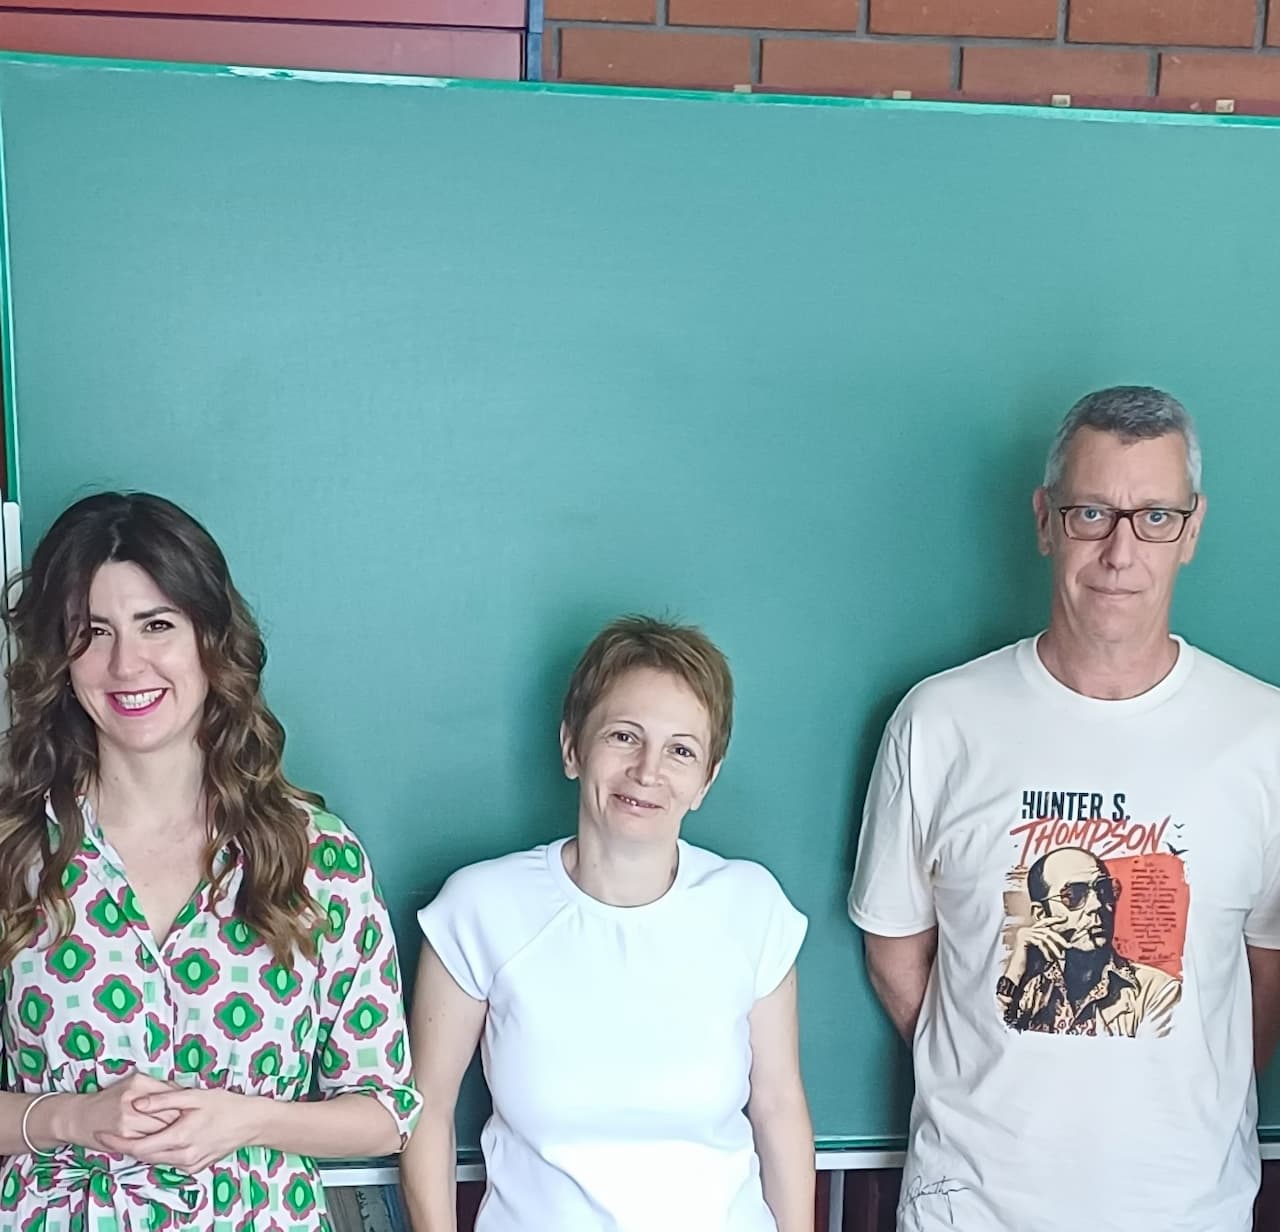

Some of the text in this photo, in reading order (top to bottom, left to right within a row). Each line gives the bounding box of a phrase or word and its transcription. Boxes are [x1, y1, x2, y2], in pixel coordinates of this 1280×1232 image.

[1022, 790, 1132, 823] HUNTER S.
[1009, 815, 1172, 868] THOMPSON
